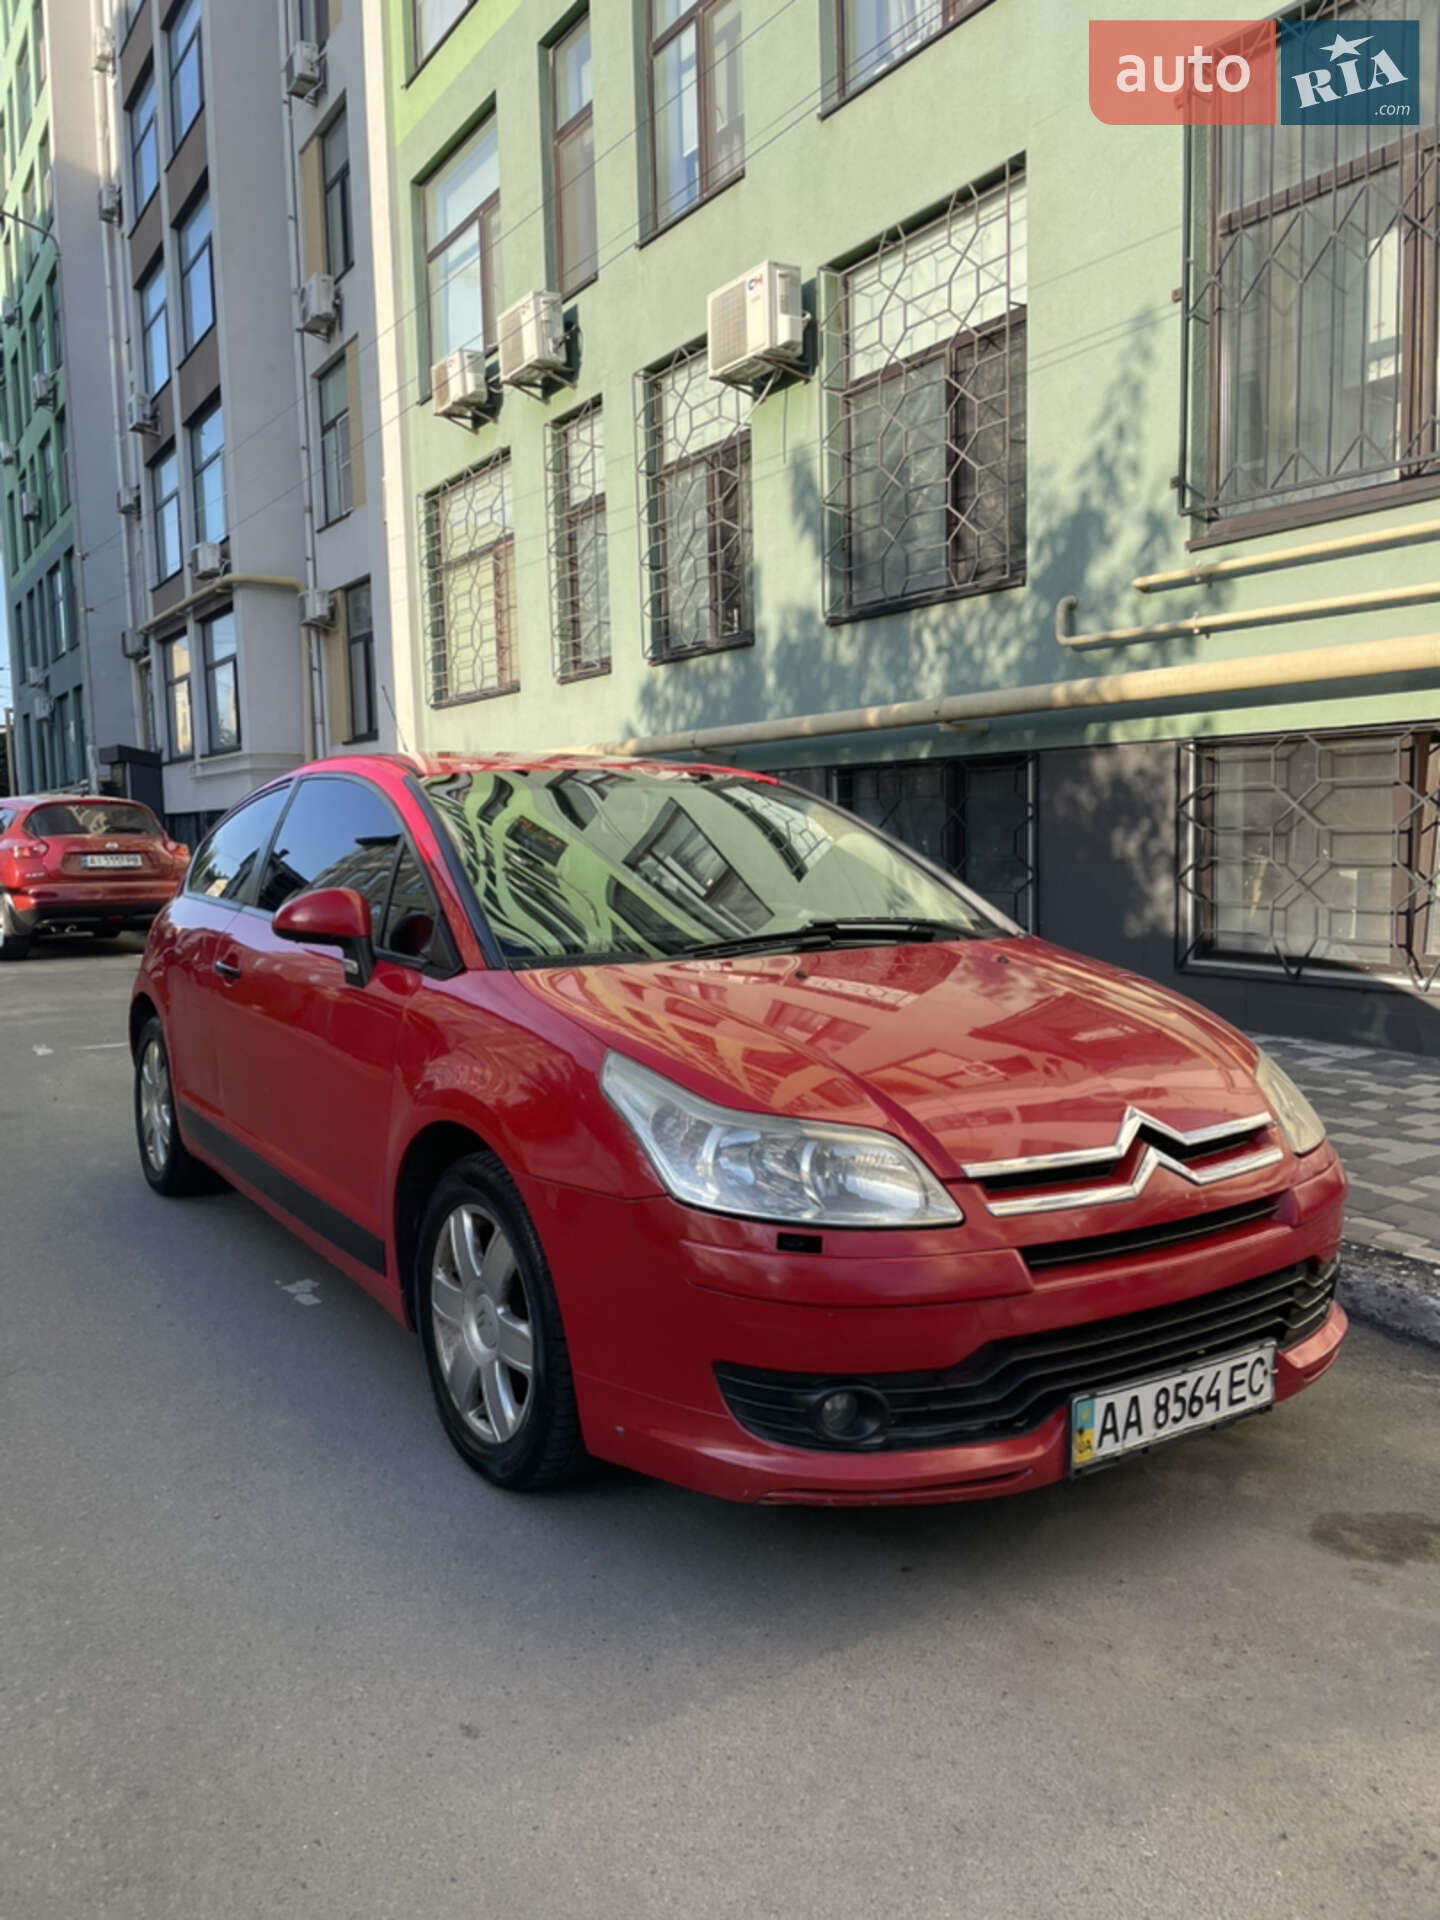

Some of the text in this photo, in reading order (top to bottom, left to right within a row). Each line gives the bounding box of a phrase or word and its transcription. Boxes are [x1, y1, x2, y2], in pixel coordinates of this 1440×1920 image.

[1098, 1357, 1266, 1448] AA 8564 EC
